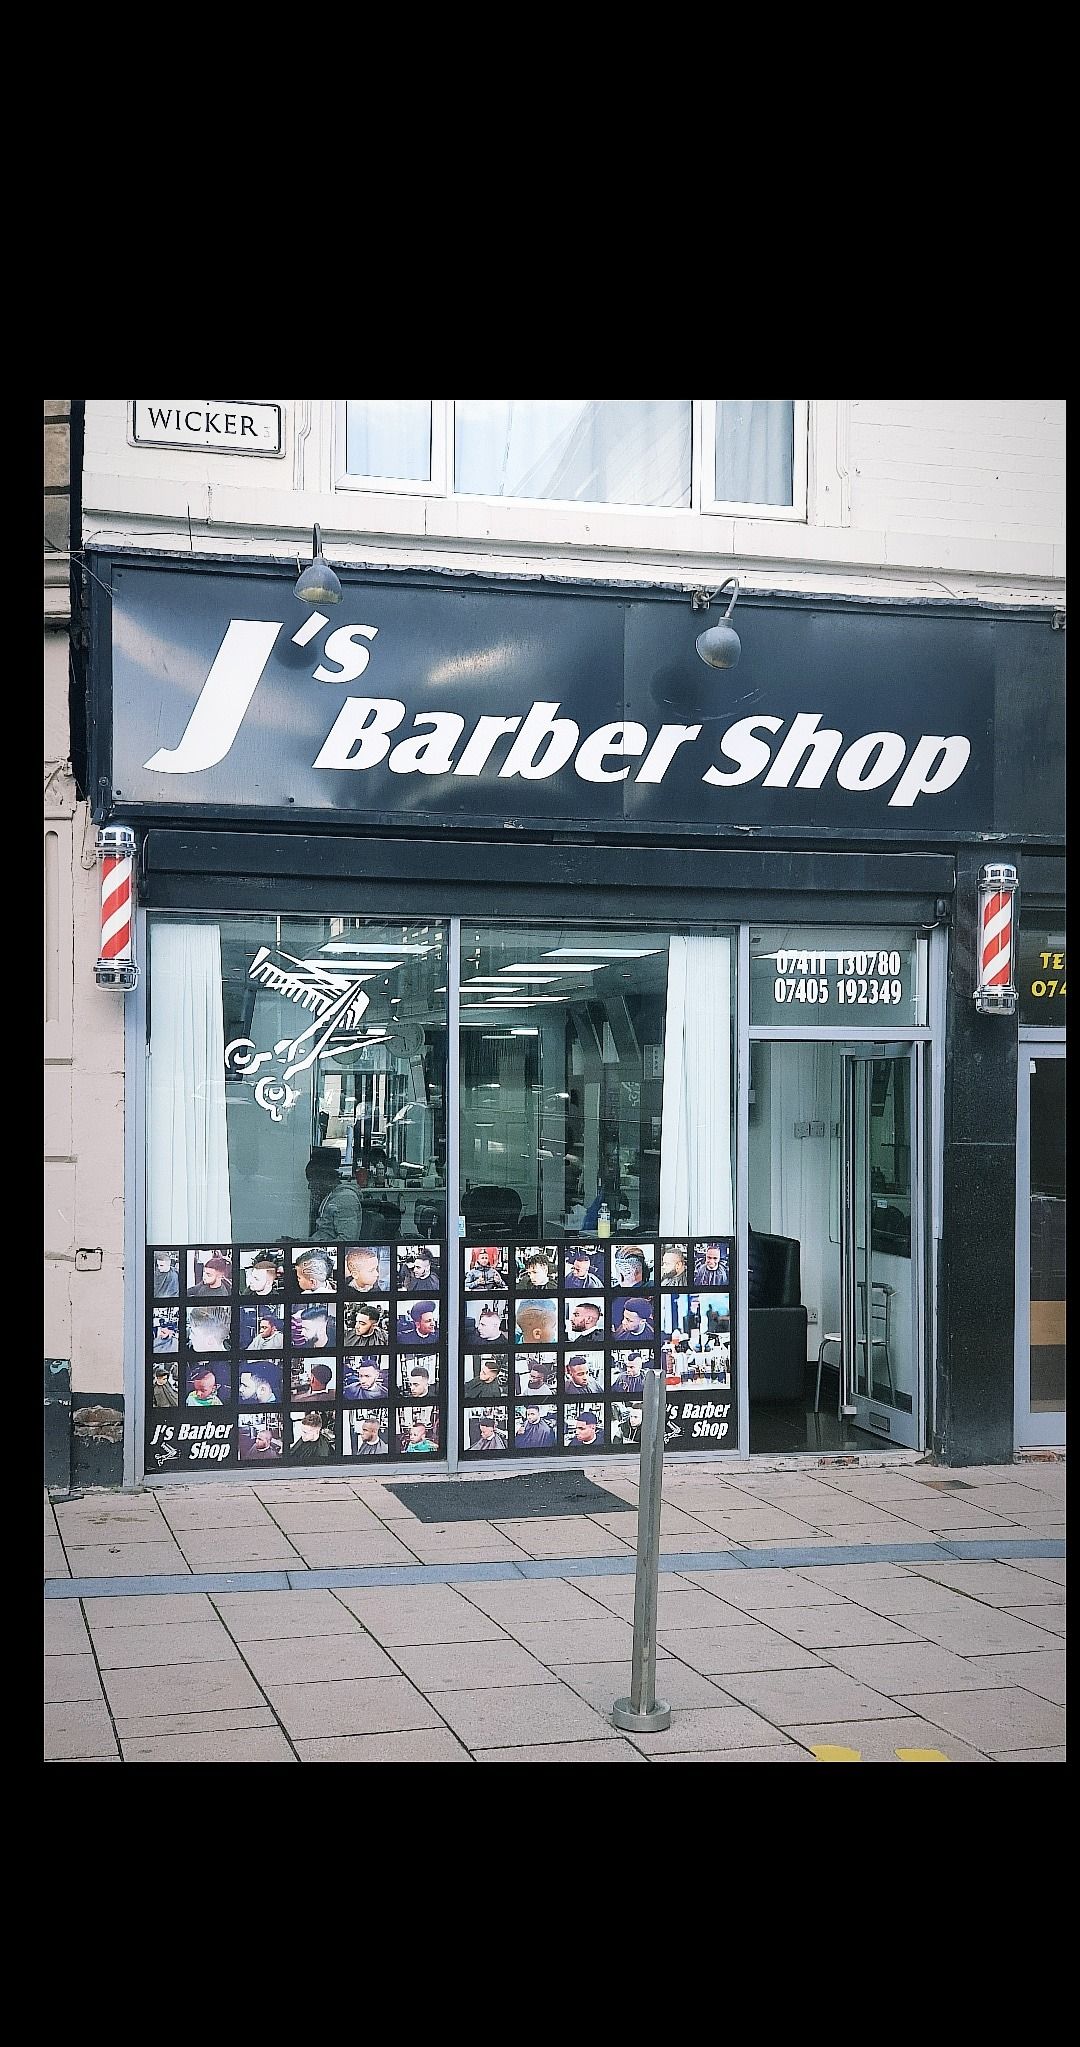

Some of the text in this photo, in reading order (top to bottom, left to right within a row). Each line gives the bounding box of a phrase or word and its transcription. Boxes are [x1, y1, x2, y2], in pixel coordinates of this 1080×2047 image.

[147, 407, 259, 437] WICKER
[142, 611, 971, 807] J's Barber Shop
[776, 950, 901, 976] 07411 130780
[774, 978, 902, 1004] 07405 192349
[665, 1401, 731, 1420] 's Barber
[150, 1421, 234, 1445] J's Barber
[691, 1420, 729, 1440] Shop
[189, 1441, 231, 1461] Shop
